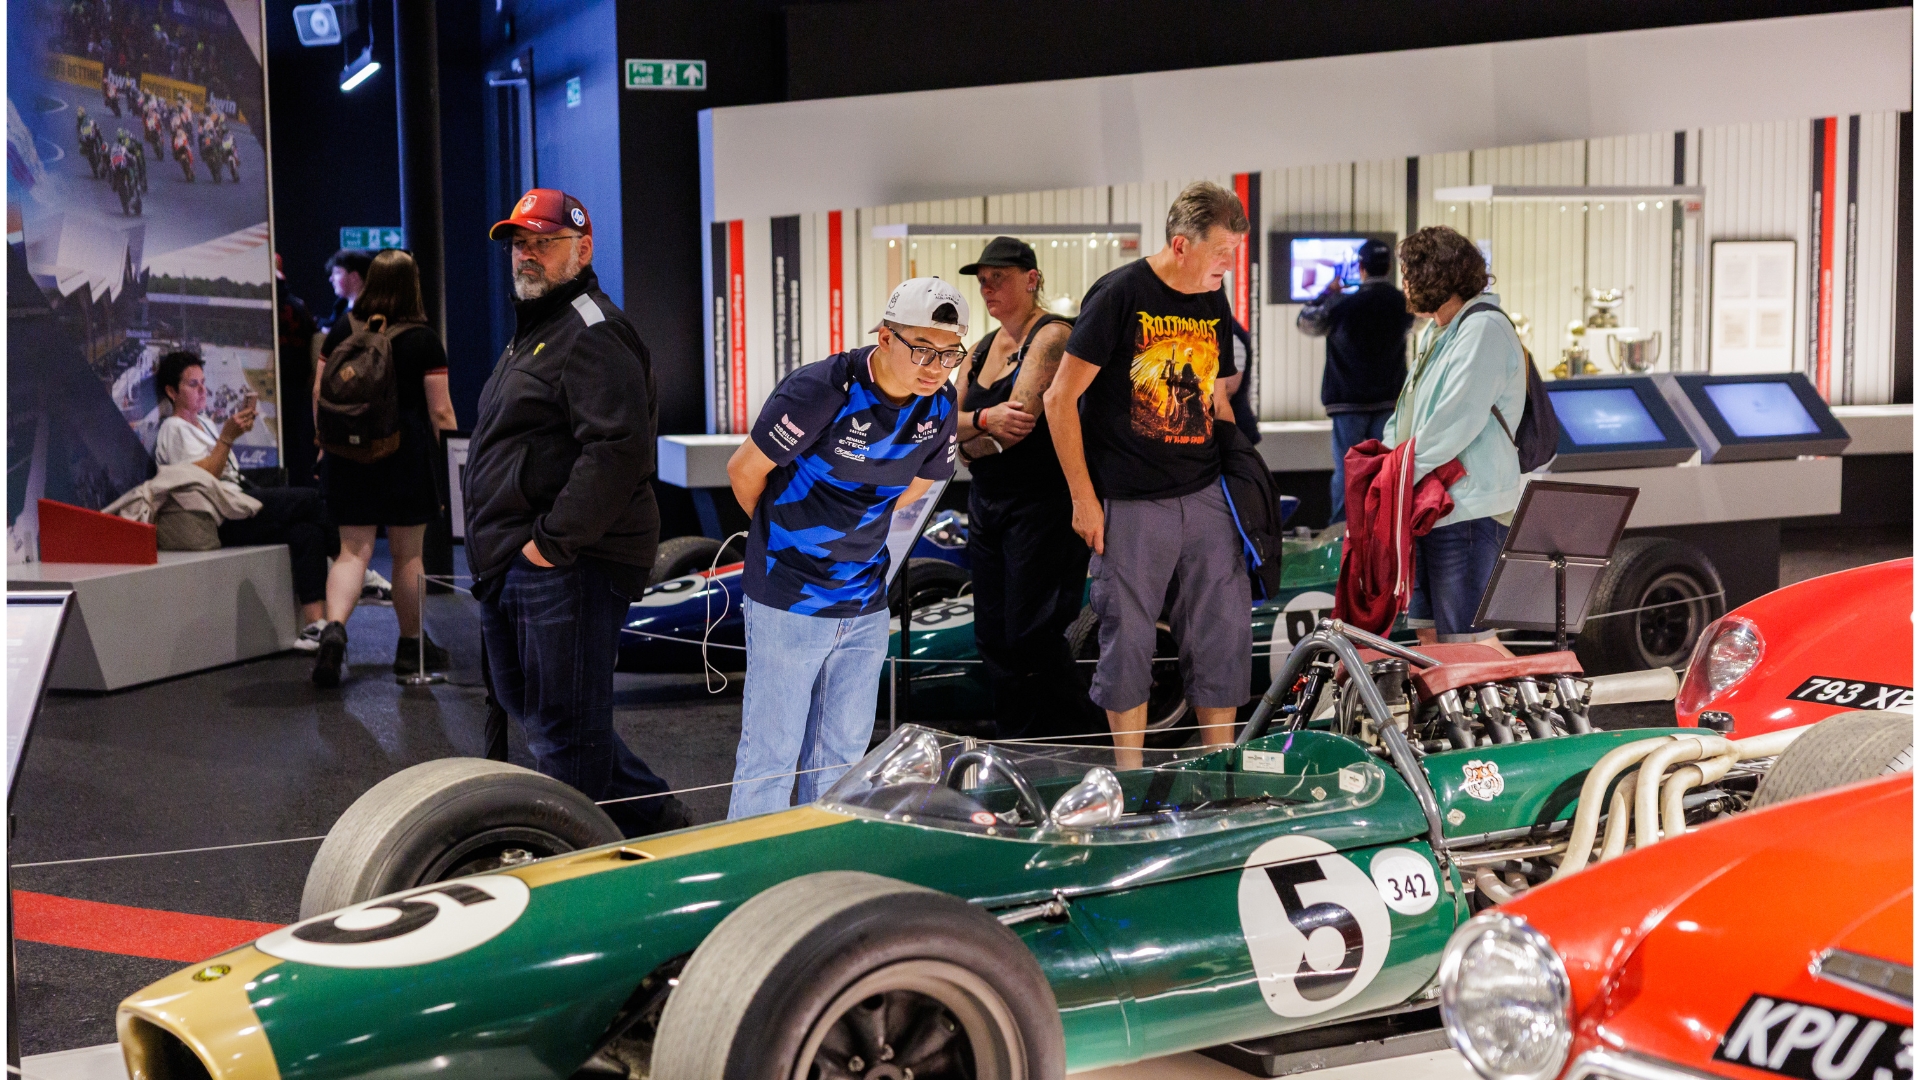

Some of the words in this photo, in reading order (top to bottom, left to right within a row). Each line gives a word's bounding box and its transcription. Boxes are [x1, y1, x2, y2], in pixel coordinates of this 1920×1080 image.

[633, 63, 654, 74] Fire
[634, 75, 653, 84] exit
[1796, 678, 1866, 704] 793
[1387, 873, 1431, 902] 342
[290, 884, 496, 945] 5
[1264, 859, 1364, 1002] 5
[1723, 996, 1887, 1080] KPU
